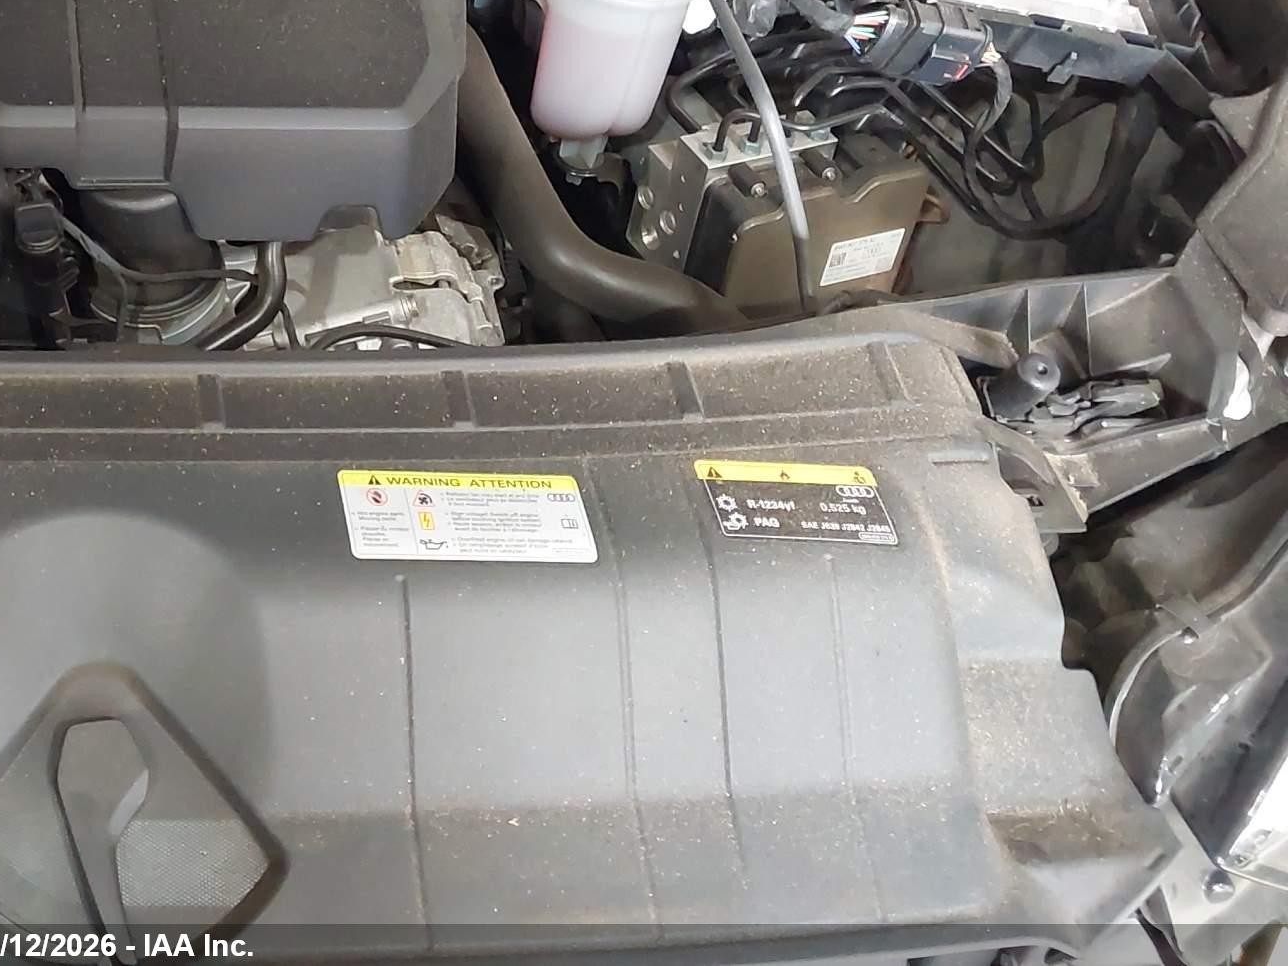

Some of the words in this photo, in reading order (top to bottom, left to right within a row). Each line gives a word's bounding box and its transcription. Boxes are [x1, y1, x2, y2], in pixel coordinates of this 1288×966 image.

[386, 476, 461, 487] WARNING
[469, 478, 552, 489] ATTENTION
[852, 505, 867, 516] kg
[753, 516, 780, 528] PAG
[801, 521, 818, 529] SAE
